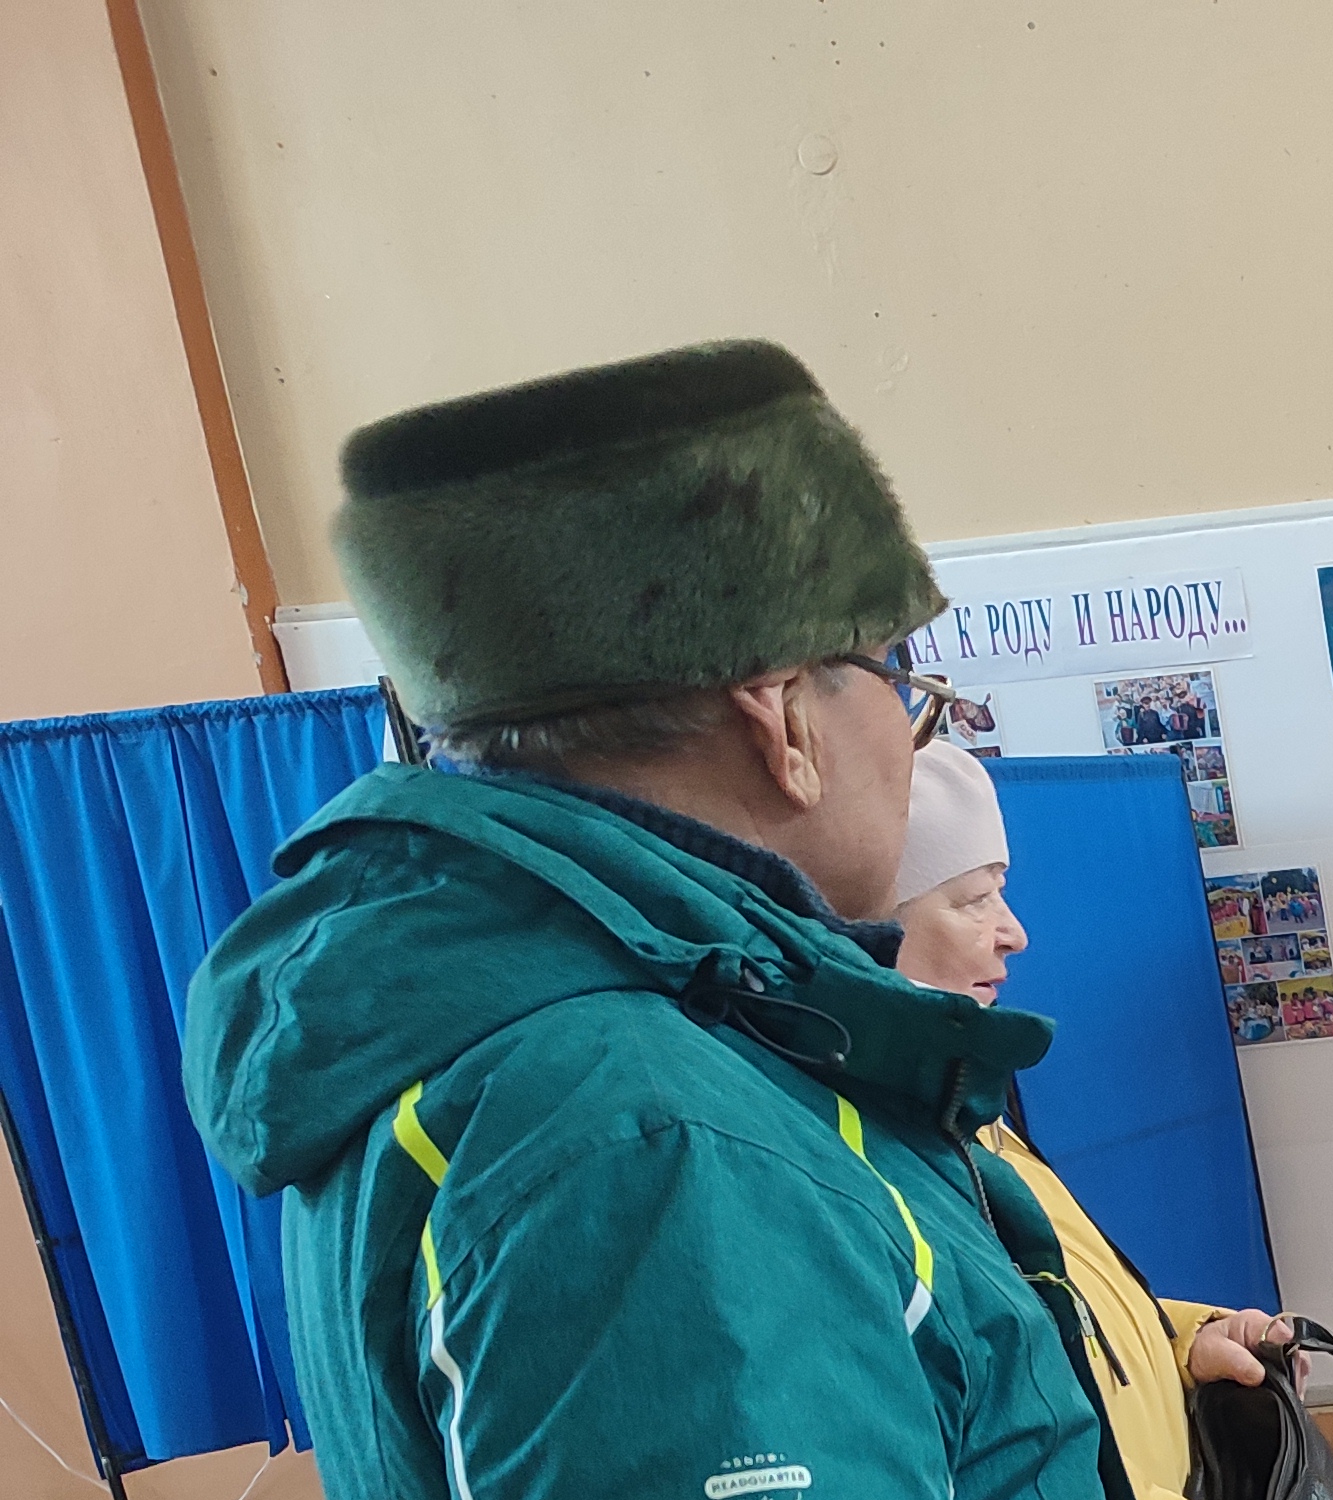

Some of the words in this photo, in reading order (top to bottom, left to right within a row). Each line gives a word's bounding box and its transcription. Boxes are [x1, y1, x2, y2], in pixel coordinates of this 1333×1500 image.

[953, 606, 978, 659] К
[984, 597, 1051, 666] РОДУ
[1072, 592, 1097, 646] И
[1104, 580, 1246, 651] НАРОДУ...
[711, 1470, 806, 1493] HEADQUARTER
